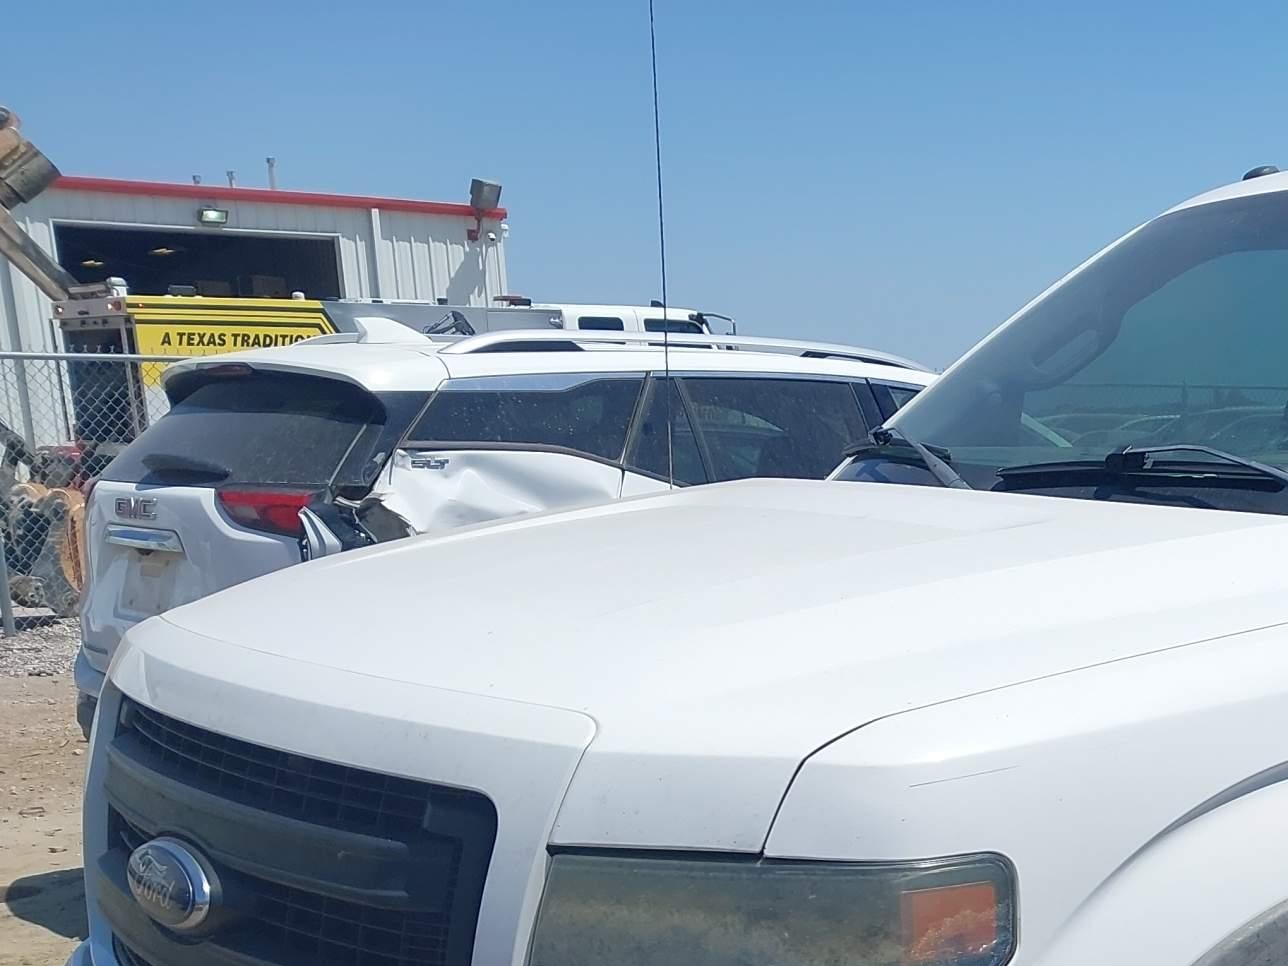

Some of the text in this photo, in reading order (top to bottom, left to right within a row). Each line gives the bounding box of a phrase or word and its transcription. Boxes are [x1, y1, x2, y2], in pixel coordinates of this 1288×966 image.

[161, 332, 172, 346] A
[177, 333, 227, 347] TEXAS
[115, 498, 158, 520] GMC
[133, 846, 176, 910] Ford
